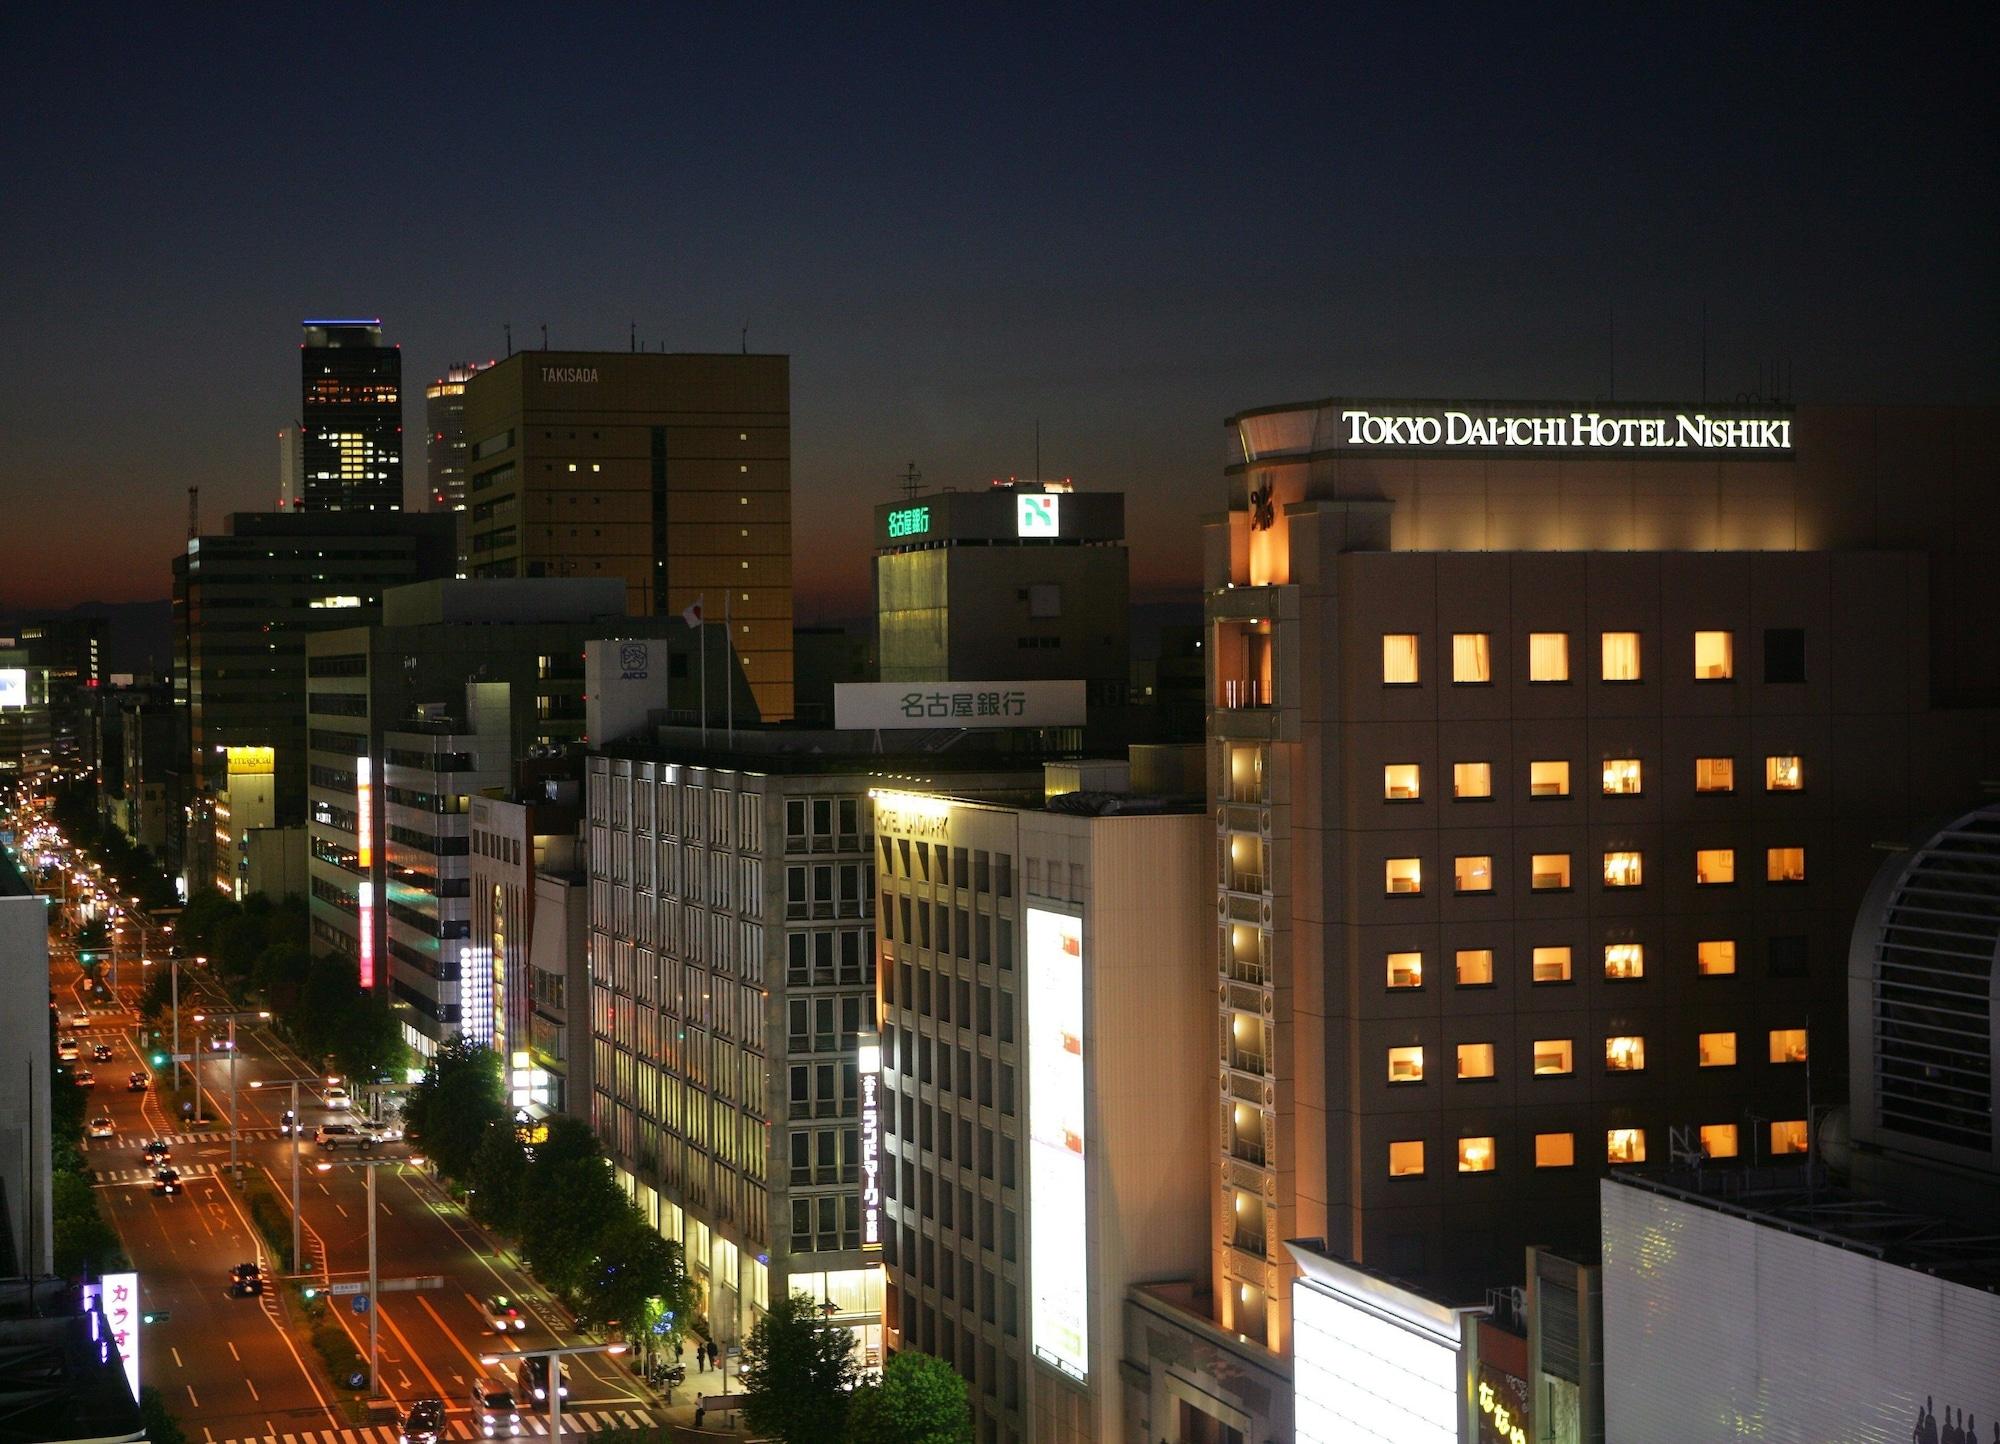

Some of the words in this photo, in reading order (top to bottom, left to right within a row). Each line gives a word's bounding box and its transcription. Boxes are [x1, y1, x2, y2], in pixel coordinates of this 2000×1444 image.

[542, 367, 599, 383] TAKISADA
[1342, 411, 1442, 445] TOKYO
[1444, 412, 1567, 446] DAI-ICHI
[1570, 413, 1674, 448] HOTEL
[1675, 414, 1792, 448] NISHIKI
[888, 506, 930, 538] 名古屋銀行
[901, 691, 1027, 718] 名古屋銀行
